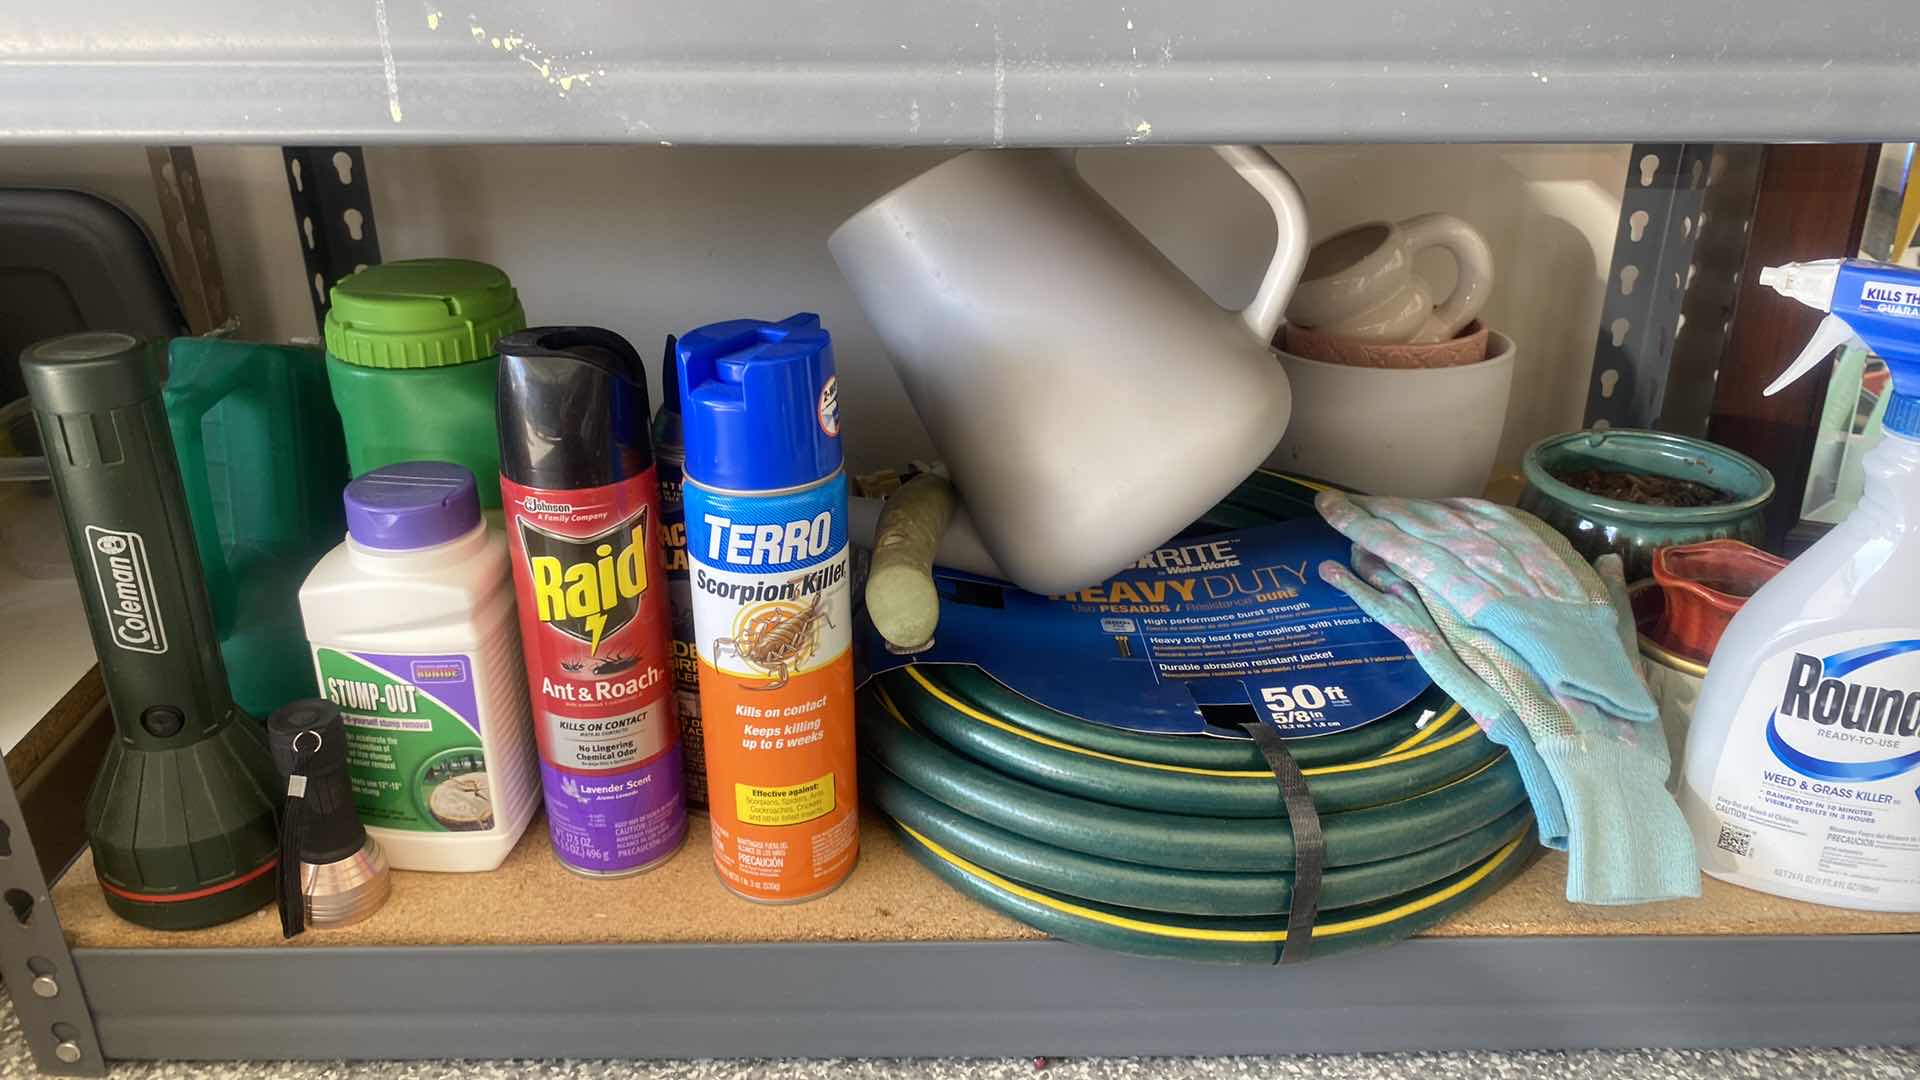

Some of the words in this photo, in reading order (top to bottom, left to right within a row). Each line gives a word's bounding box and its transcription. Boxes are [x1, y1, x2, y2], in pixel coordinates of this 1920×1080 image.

[1867, 288, 1901, 302] KILLS
[525, 497, 571, 512] Johnson
[544, 514, 570, 523] Family
[571, 512, 608, 522] Company
[704, 512, 832, 566] TERRO
[531, 525, 648, 622] Raid
[1166, 559, 1241, 575] WaterWorks
[697, 569, 795, 604] Scorpion
[800, 559, 847, 596] Killer
[1202, 561, 1307, 599] DUTY
[111, 556, 151, 644] Coleman
[1100, 603, 1170, 614] PESADOS
[1256, 587, 1299, 603] DURE
[1143, 618, 1168, 627] High
[1169, 613, 1235, 627] performance
[1236, 608, 1265, 619] burst
[1267, 601, 1311, 615] strength
[1150, 635, 1181, 646] Heavy
[1183, 634, 1207, 645] duty
[1209, 632, 1232, 642] lead
[1233, 630, 1254, 639] free
[1256, 623, 1307, 638] couplings
[1308, 619, 1332, 630] with
[1333, 616, 1361, 626] Hose
[1159, 662, 1201, 671] Durable
[1202, 661, 1249, 671] abrasion
[1251, 655, 1299, 667] resistant
[1299, 650, 1335, 664] jacket
[541, 676, 576, 701] Ant
[578, 687, 594, 702] &
[595, 665, 659, 701] Roach
[326, 677, 418, 713] STUMP-OUT
[735, 704, 763, 718] Kills
[764, 708, 781, 718] on
[783, 695, 828, 717] contact
[559, 720, 586, 732] KILLS
[587, 723, 603, 731] ON
[605, 711, 649, 730] CONTACT
[744, 723, 781, 738] Keeps
[784, 718, 822, 736] killing
[578, 744, 591, 753] No
[592, 740, 635, 754] Lingering
[742, 738, 758, 750] up
[760, 739, 773, 750] to
[775, 739, 785, 749] 6
[786, 730, 825, 748] weeks
[1816, 728, 1901, 749] READY-TO-USE
[576, 752, 615, 762] Chemical
[617, 747, 638, 758] Odor
[580, 784, 624, 794] Lavender
[626, 774, 652, 790] Scent
[752, 789, 787, 798] Effective
[788, 783, 819, 797] against:
[1763, 770, 1797, 787] WEED
[1799, 780, 1809, 791] &
[1811, 782, 1853, 800] GRASS
[1854, 790, 1894, 805] KILLER
[1715, 803, 1747, 819] CAUTION
[1764, 797, 1794, 809] VISIBLE
[1795, 805, 1828, 817] RESULTS
[1829, 811, 1839, 819] IN
[1847, 815, 1876, 824] HOURS
[1766, 790, 1814, 807] RAINPROOF
[1815, 801, 1825, 809] IN
[1838, 806, 1874, 817] MINUTES
